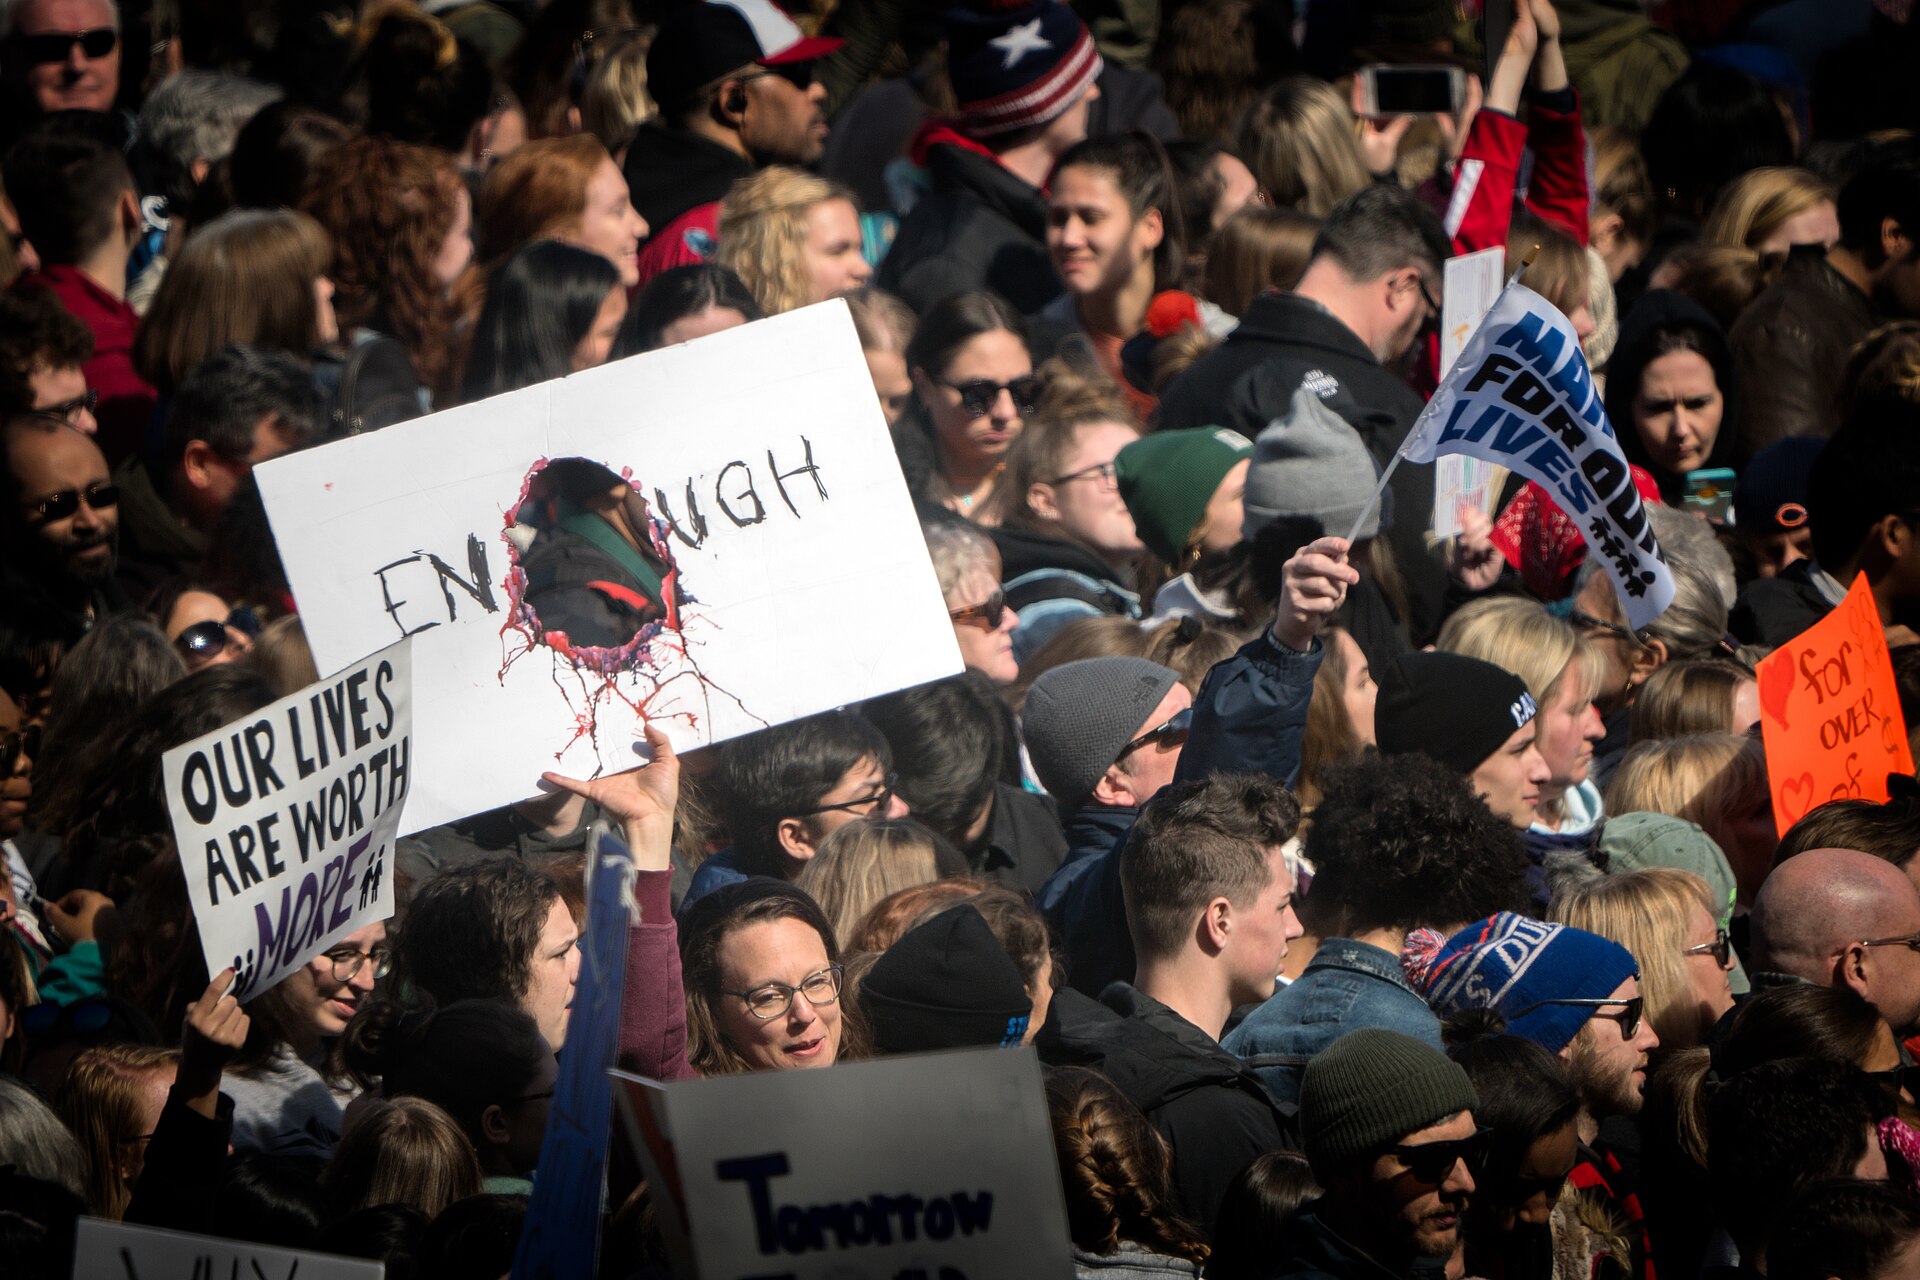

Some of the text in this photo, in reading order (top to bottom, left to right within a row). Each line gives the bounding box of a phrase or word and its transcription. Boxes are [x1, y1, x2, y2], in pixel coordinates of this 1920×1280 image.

[1437, 399, 1598, 515] LIVES
[1465, 353, 1588, 452] FOR
[1800, 641, 1852, 705] for
[1820, 688, 1881, 751] OVER
[182, 660, 393, 825] OUR LIVES
[205, 736, 408, 906] ARE WORTH
[245, 830, 373, 990] MORE
[715, 1152, 994, 1256] Tomorrow
